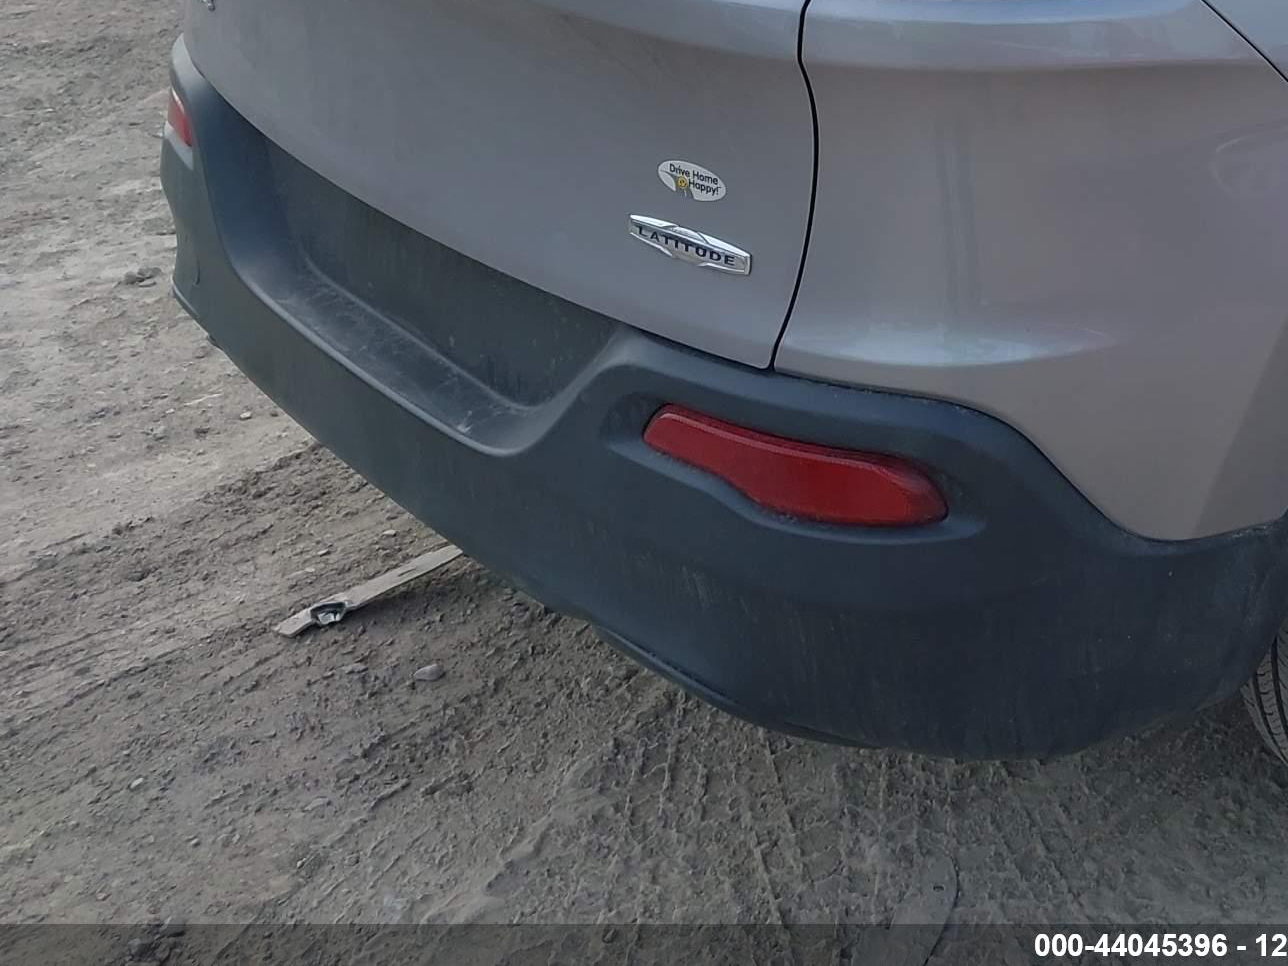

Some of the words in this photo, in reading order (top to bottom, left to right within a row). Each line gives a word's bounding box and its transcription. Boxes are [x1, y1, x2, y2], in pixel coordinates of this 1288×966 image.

[669, 162, 690, 178] Drive
[693, 169, 719, 186] Home
[635, 225, 736, 267] LATITUDE
